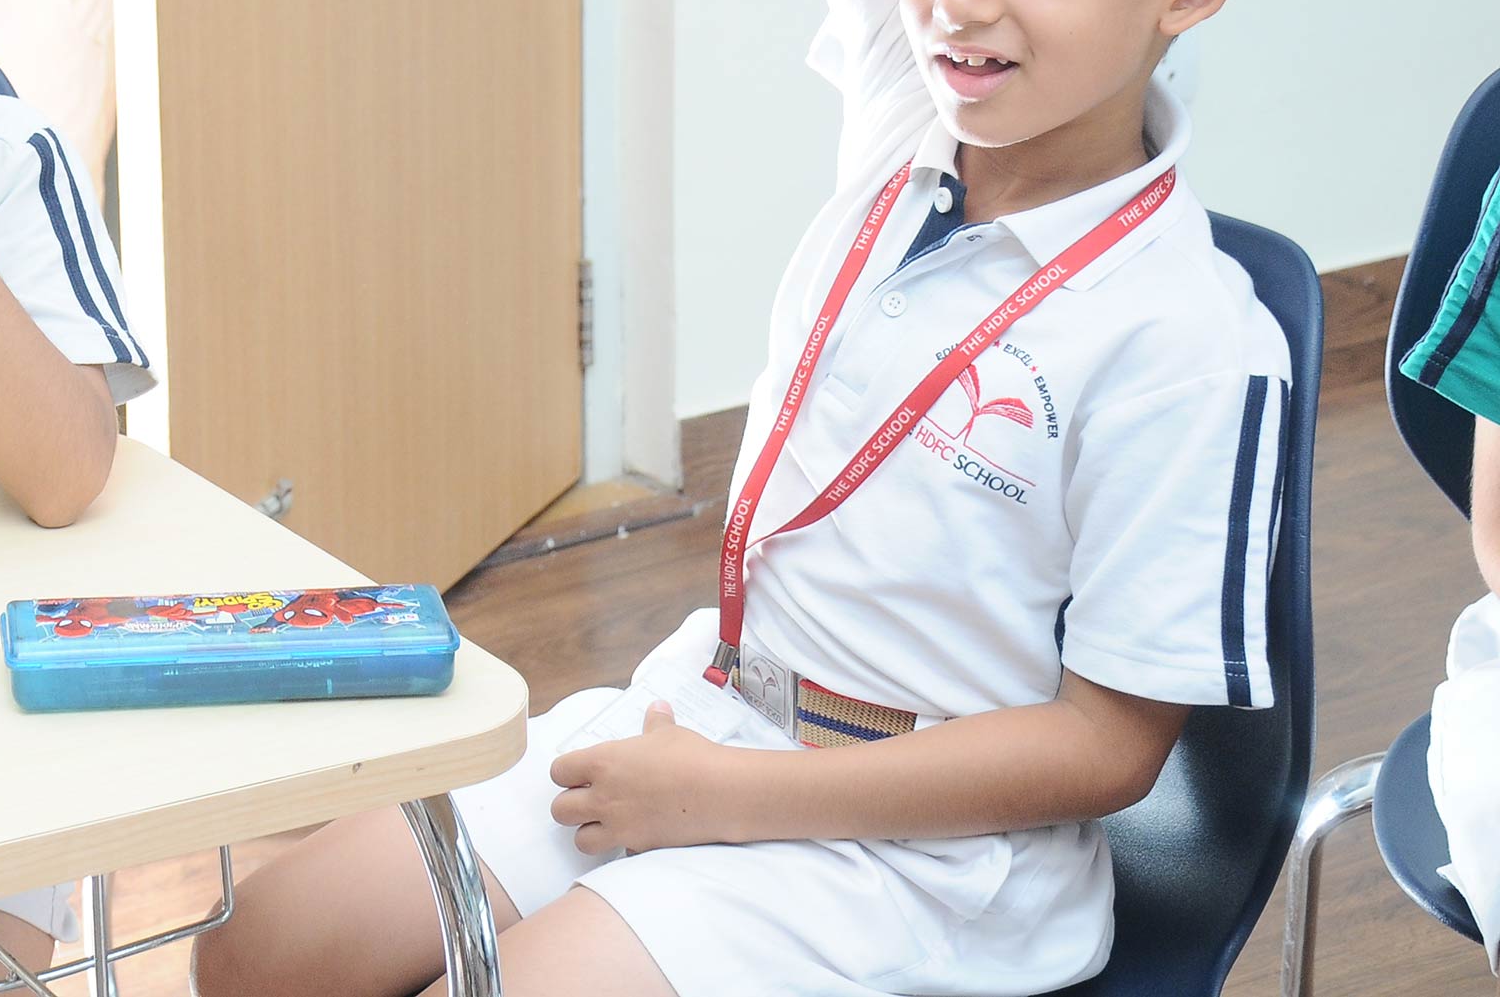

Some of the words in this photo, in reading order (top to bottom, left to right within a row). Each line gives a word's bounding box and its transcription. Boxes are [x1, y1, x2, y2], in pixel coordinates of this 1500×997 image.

[854, 227, 874, 251] THE
[868, 192, 892, 225] HDFC
[888, 163, 911, 189] SCH
[1117, 204, 1143, 227] THE
[1140, 182, 1166, 211] HDFC
[959, 331, 986, 356] THE
[983, 302, 1018, 335] HDFC
[1015, 264, 1068, 307] SCHOOL
[774, 407, 793, 433] THE
[787, 368, 807, 405] HDFC
[802, 314, 830, 368] SCHOOL
[1003, 343, 1033, 367] EXCEL
[1033, 375, 1059, 439] EMPOWER
[826, 480, 849, 504] THE
[846, 450, 877, 483] HDFC
[872, 405, 916, 454] SCHOOL
[914, 424, 956, 461] HDFC
[953, 454, 1028, 505] SCHOOL
[727, 498, 752, 552] SCHOOL
[193, 591, 274, 608] SPIDEY!
[724, 552, 737, 581] HDFC
[724, 581, 736, 598] THE
